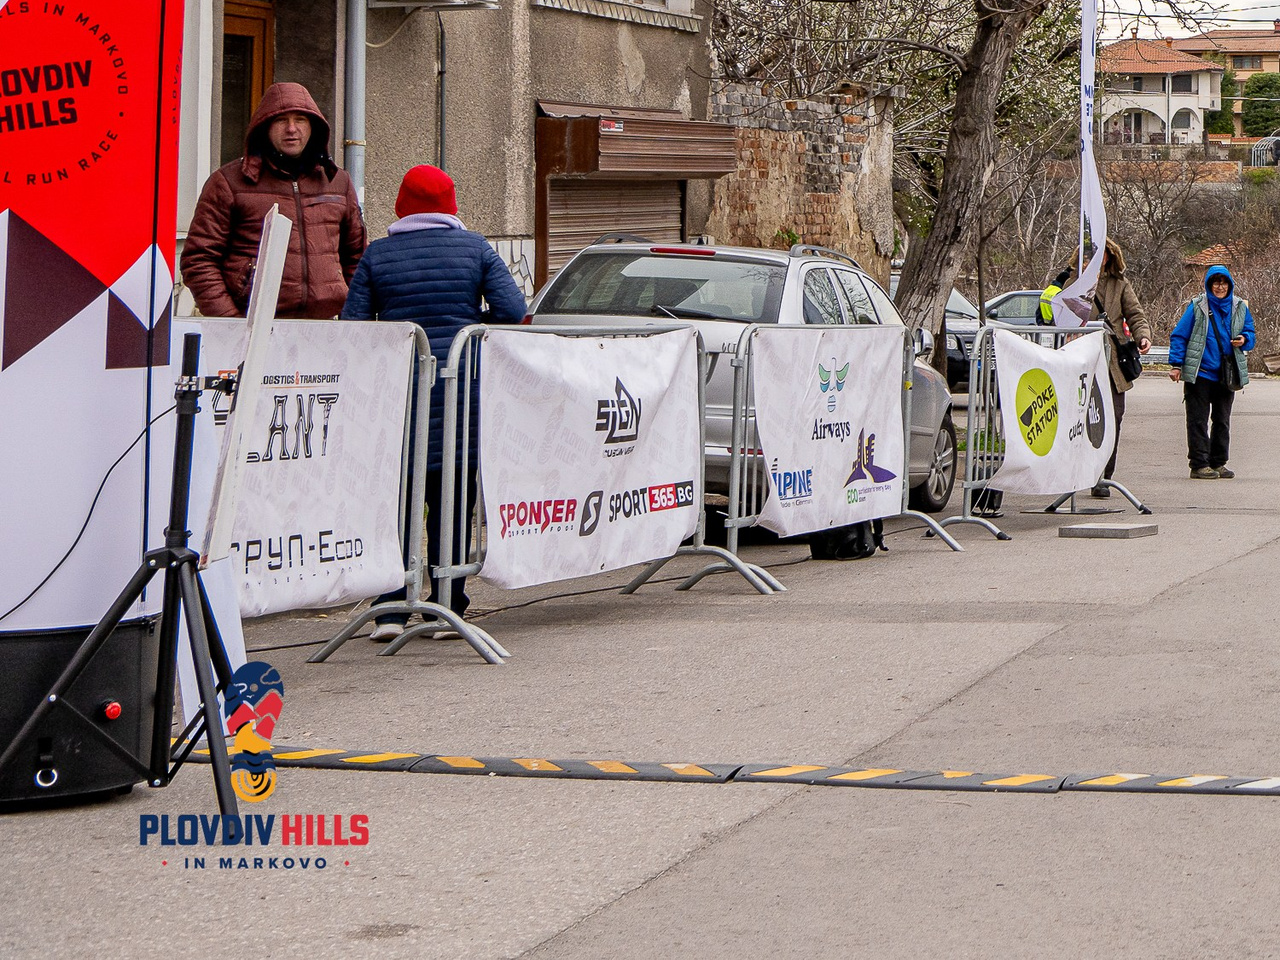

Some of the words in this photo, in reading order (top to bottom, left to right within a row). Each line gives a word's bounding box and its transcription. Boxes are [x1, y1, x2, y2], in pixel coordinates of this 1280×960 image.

[43, 2, 66, 17] IN
[74, 12, 130, 95] MARKOVO
[0, 59, 93, 98] OVDIV
[26, 168, 69, 186] RUN
[77, 129, 119, 171] RACE
[300, 374, 340, 384] TRANSPORT
[1032, 384, 1055, 415] POKE
[811, 417, 851, 442] Airways
[1026, 404, 1058, 446] STATION
[499, 498, 577, 540] SPONSER
